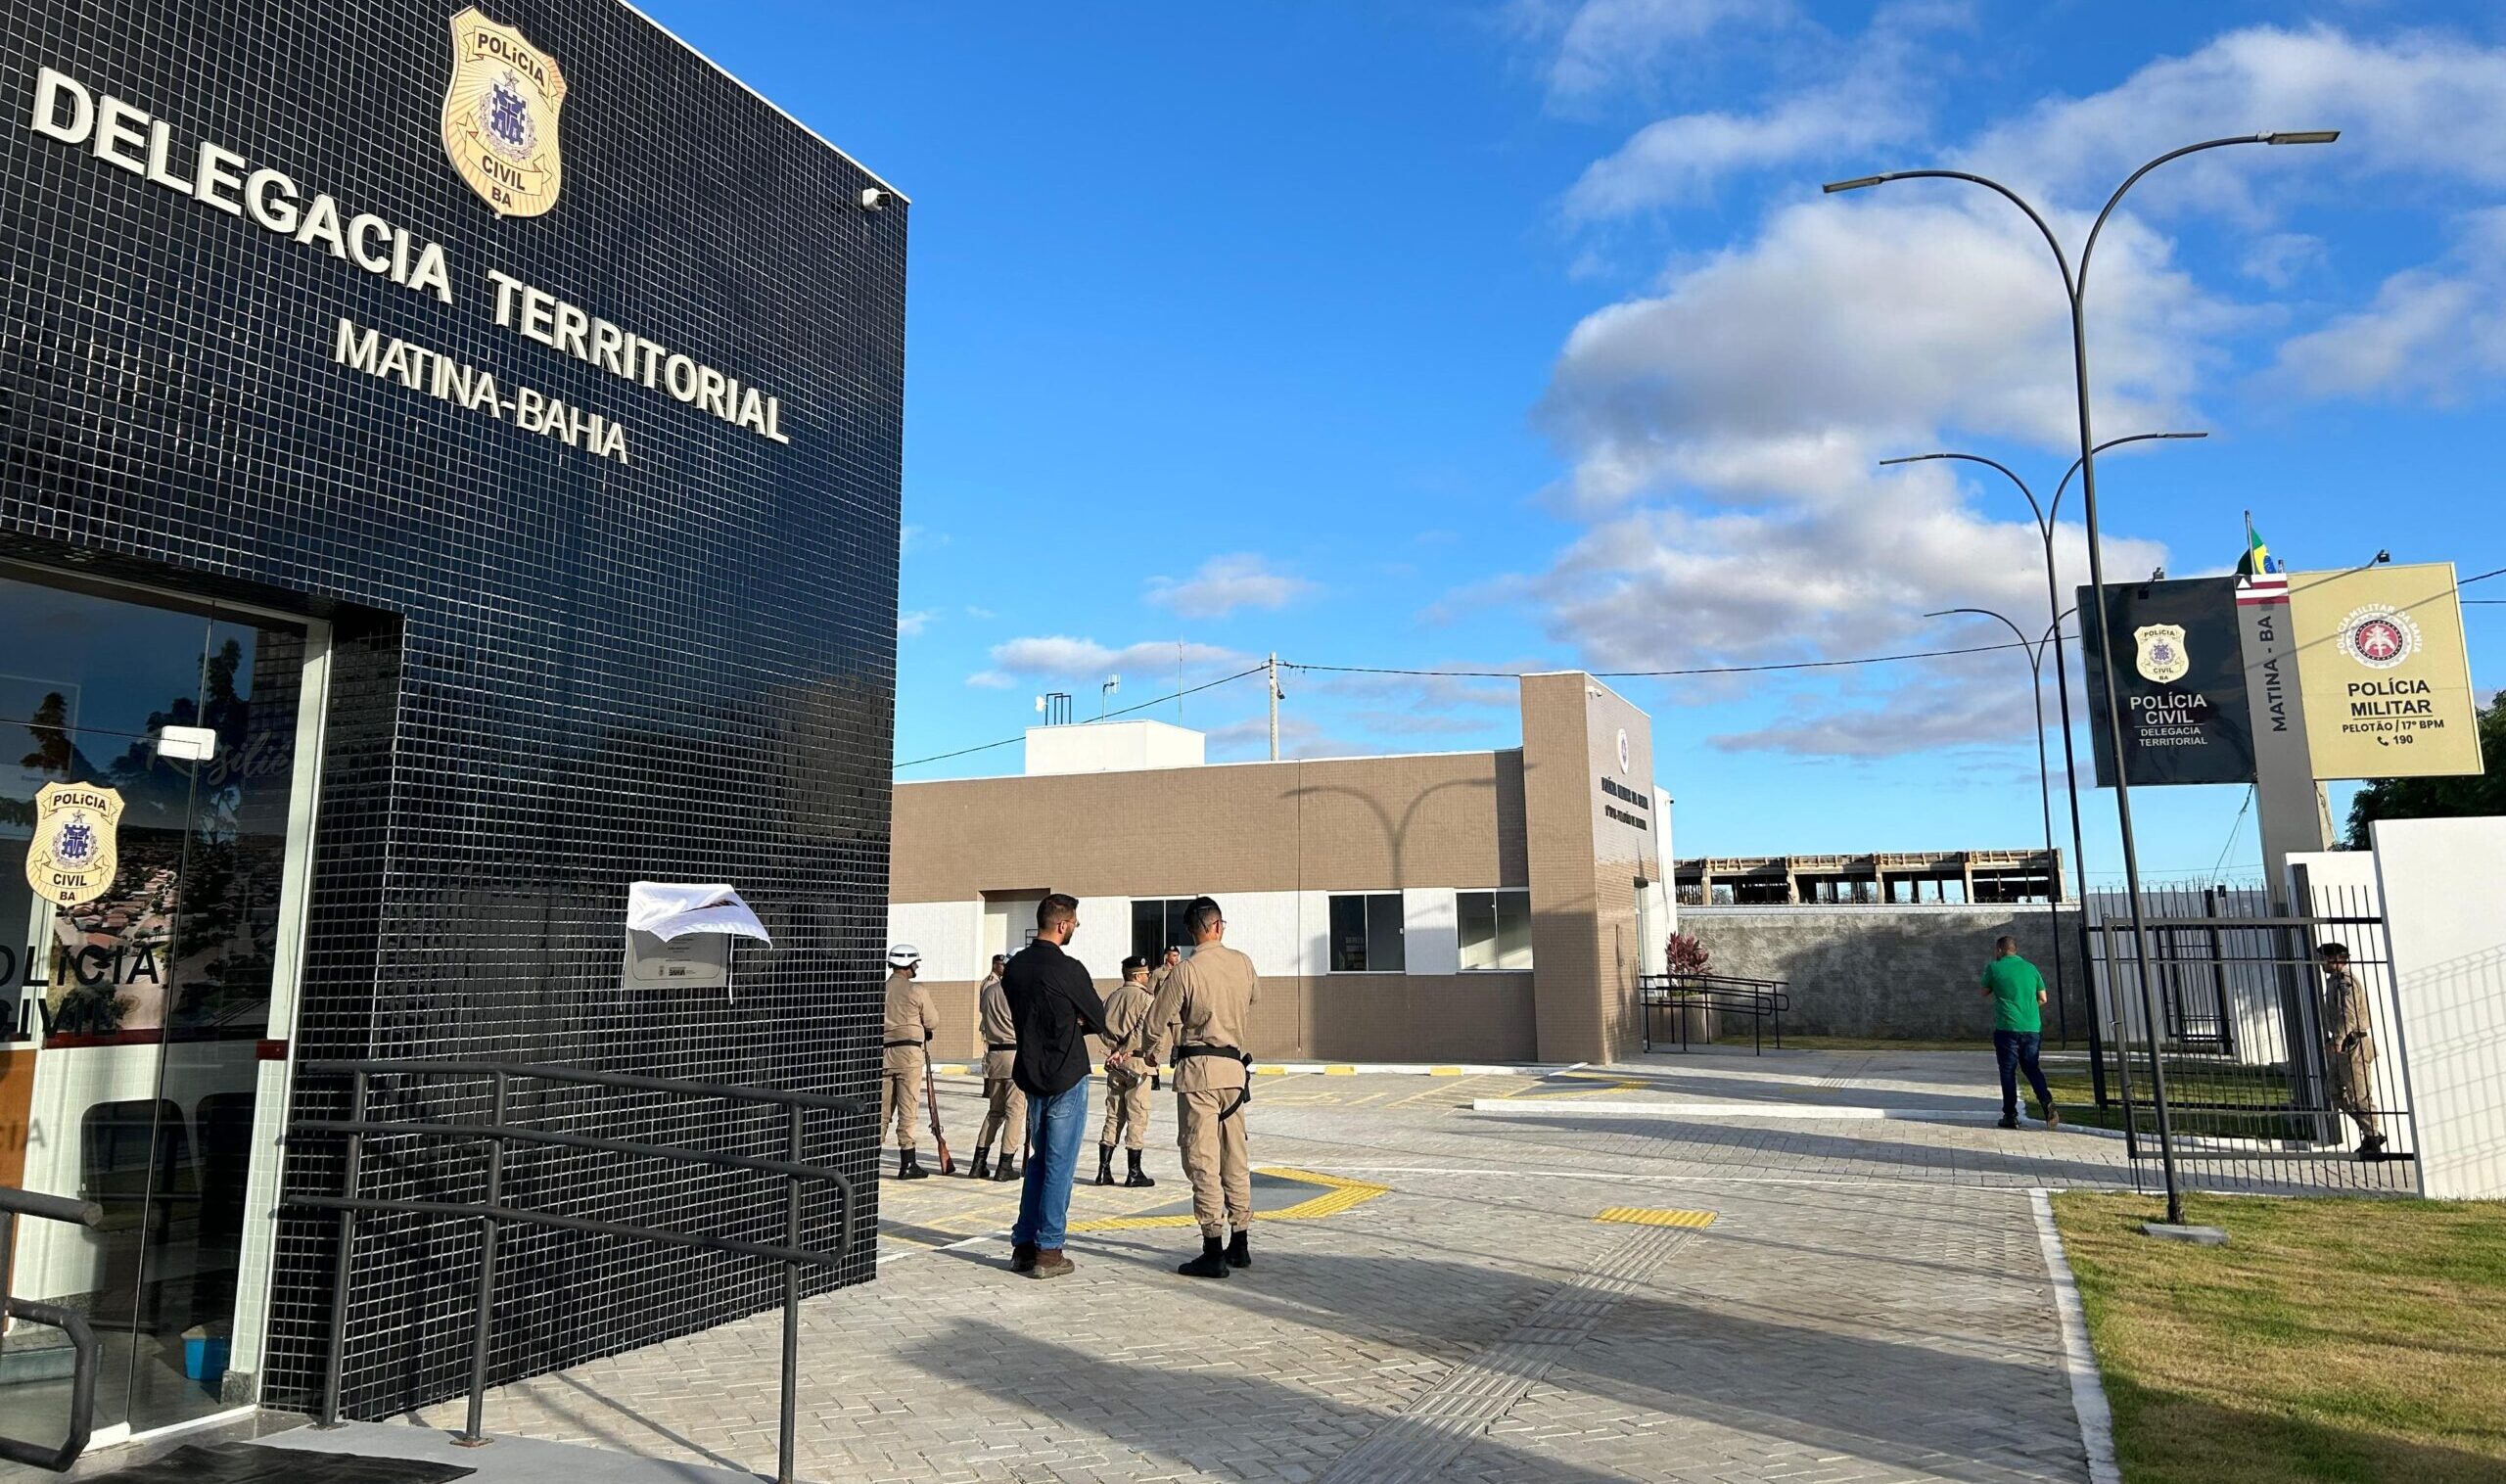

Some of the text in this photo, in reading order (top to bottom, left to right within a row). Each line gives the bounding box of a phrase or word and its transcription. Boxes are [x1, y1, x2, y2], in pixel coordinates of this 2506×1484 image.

[482, 155, 526, 192] CIVIL
[491, 186, 513, 209] BA
[31, 66, 789, 445] DELEGACIA TERRITORIAL
[335, 318, 628, 464] MATINA-BAHIA
[2257, 615, 2274, 642] BA
[2263, 658, 2288, 732] MATINA
[2347, 677, 2431, 697] POLÍCIA
[2130, 691, 2207, 710] POLÍCIA
[2350, 699, 2433, 717] MILITAR
[2145, 710, 2194, 724] CIVIL
[2342, 720, 2392, 733] PELOTÃO
[2419, 719, 2444, 729] BPM
[2140, 726, 2202, 736] DELEGACIA
[2392, 735, 2414, 745] 190
[2139, 736, 2208, 747] TERRITORIAL
[53, 873, 87, 887] CIVIL
[60, 892, 75, 902] BA
